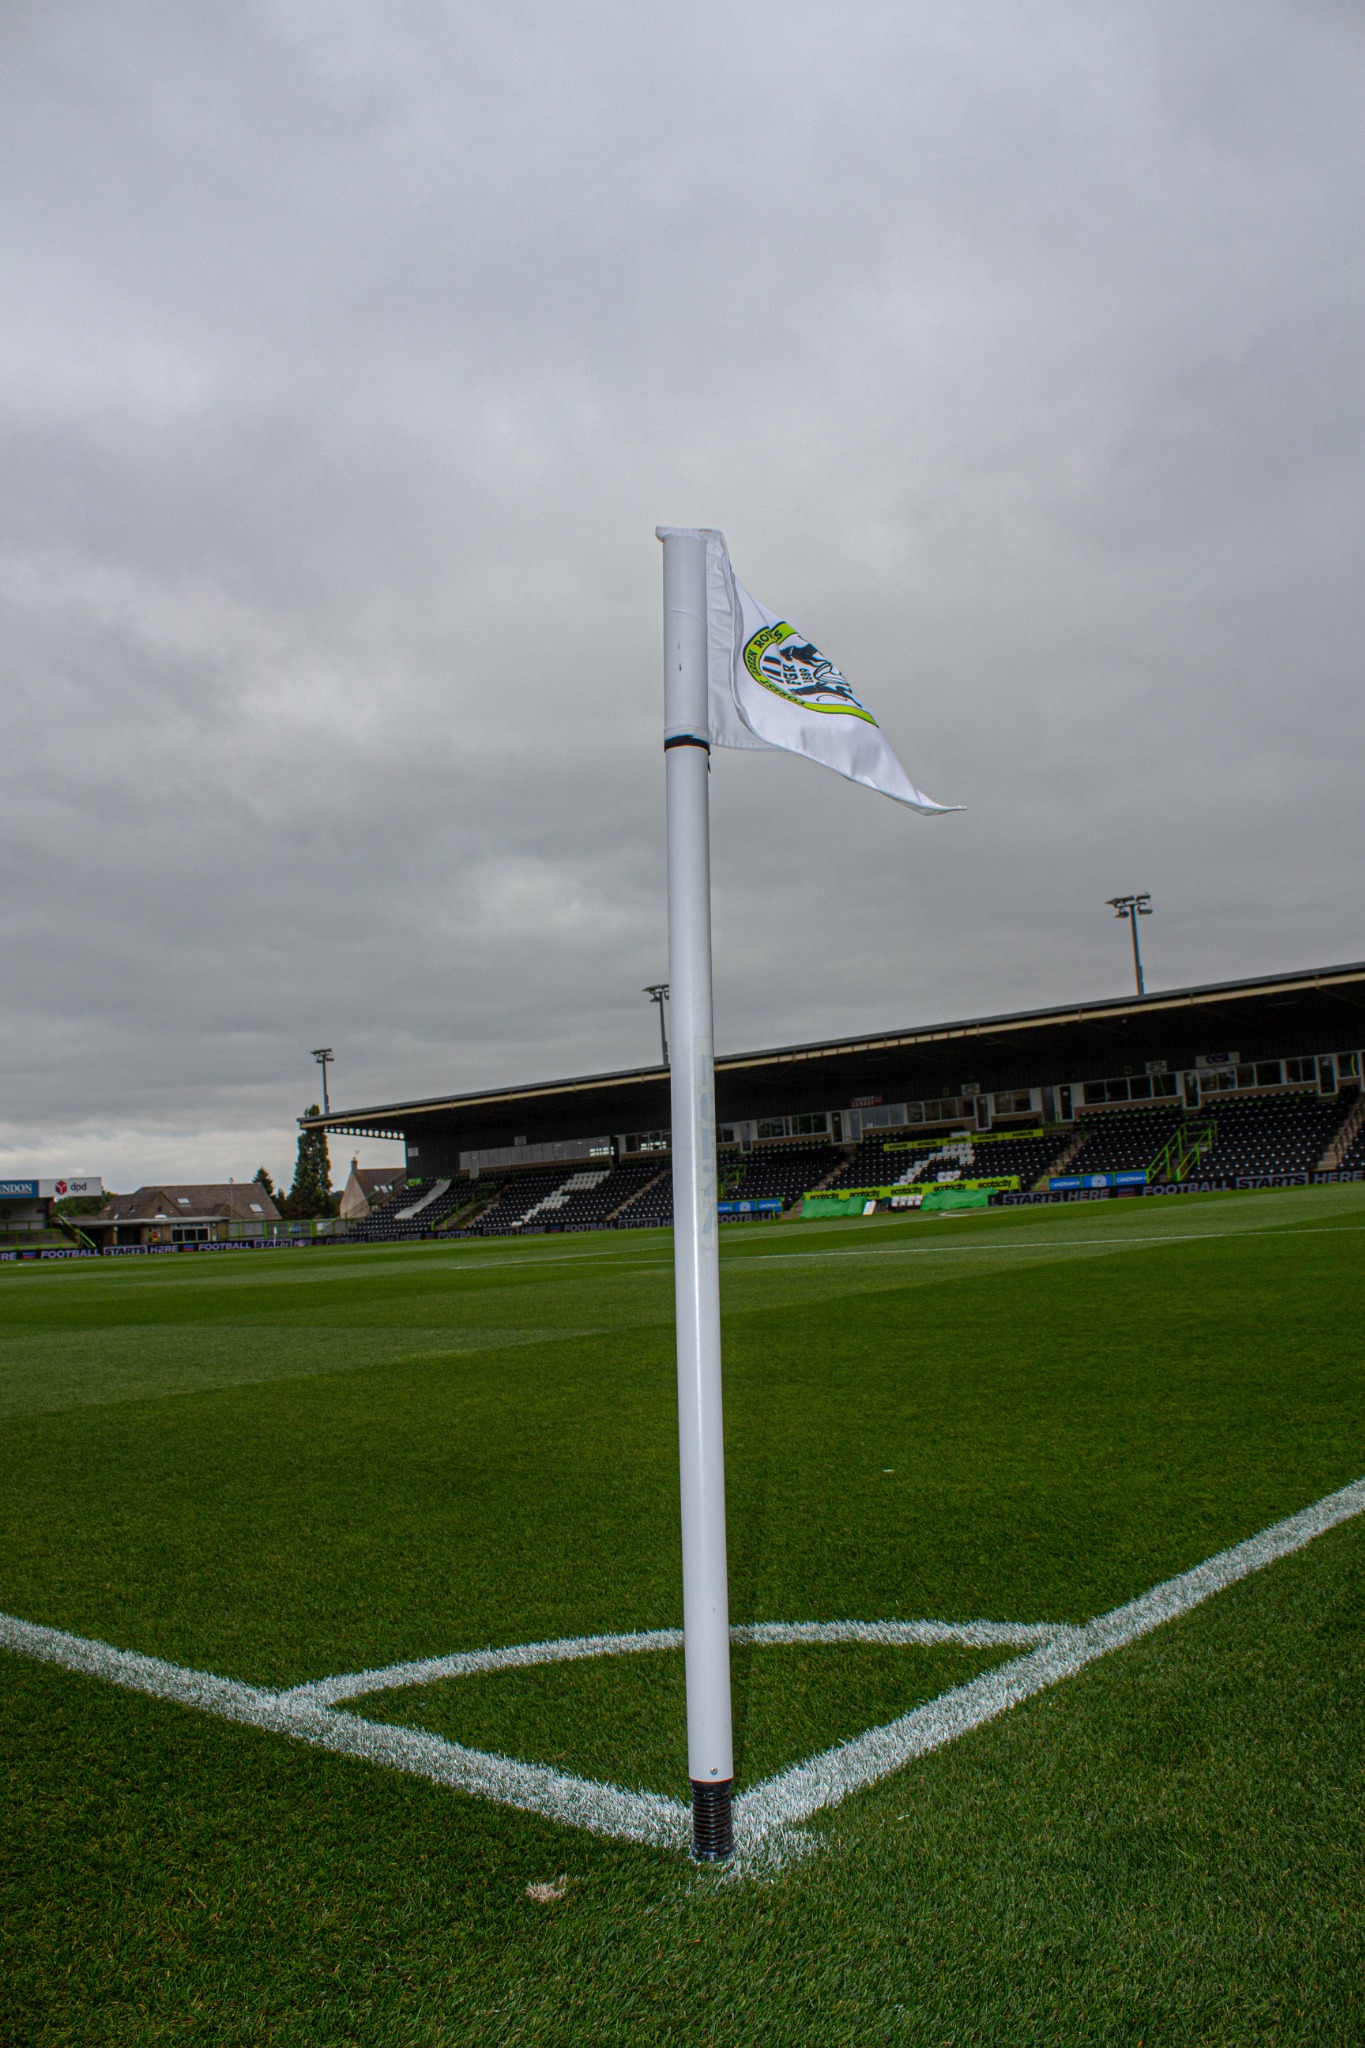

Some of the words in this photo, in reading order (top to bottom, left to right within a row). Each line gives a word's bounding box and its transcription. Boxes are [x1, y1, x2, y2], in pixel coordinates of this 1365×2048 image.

[747, 649, 762, 677] GREEN
[783, 664, 802, 686] FGR
[799, 668, 815, 683] 1889
[70, 1182, 87, 1192] dpd
[978, 1179, 1012, 1189] ecotricity
[1142, 1180, 1232, 1197] FOOTBALL
[1238, 1174, 1306, 1189] STARTS
[1312, 1169, 1364, 1184] HERE
[890, 1186, 922, 1195] ecotricity
[1004, 1191, 1064, 1205] STARTS
[1067, 1189, 1110, 1201] HERE
[564, 1221, 616, 1232] FOOTBALL
[619, 1218, 659, 1229] STARTS
[326, 1236, 366, 1245] FOOTBALL
[369, 1234, 398, 1243] STARTS
[400, 1232, 422, 1241] HERE
[437, 1229, 481, 1240] FOOTBALL
[484, 1227, 519, 1236] STARTS
[520, 1226, 547, 1235] HERE
[40, 1248, 101, 1260] FOOTBALL
[104, 1245, 147, 1256] STARTS
[149, 1244, 179, 1255] HERE
[198, 1240, 253, 1251] FOOTBALL
[255, 1239, 292, 1249] STARTS
